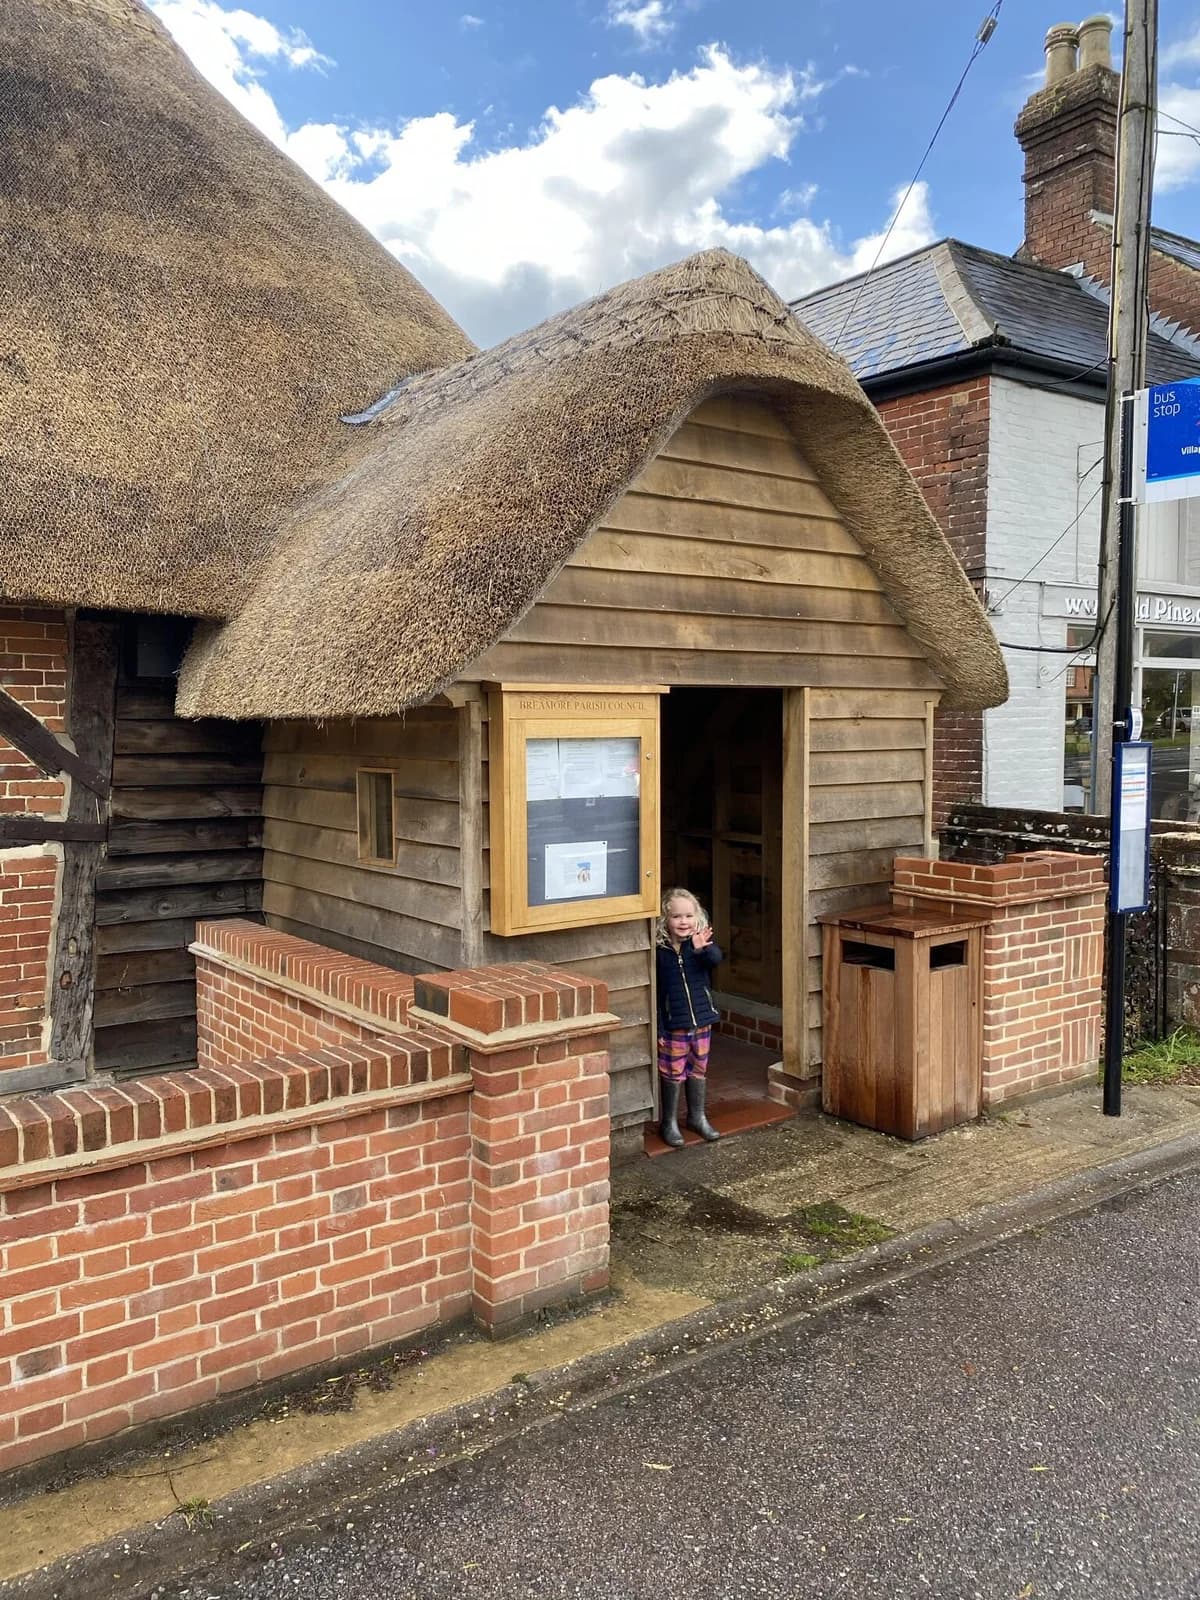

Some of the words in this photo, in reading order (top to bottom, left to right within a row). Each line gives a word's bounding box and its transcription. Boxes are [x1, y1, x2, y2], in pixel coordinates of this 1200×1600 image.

[1154, 391, 1176, 405] bus
[1153, 403, 1180, 418] stop
[1181, 445, 1200, 456] Villa
[519, 699, 571, 711] BREAMORE
[574, 700, 606, 711] PARISH
[607, 700, 645, 712] COUNCIL
